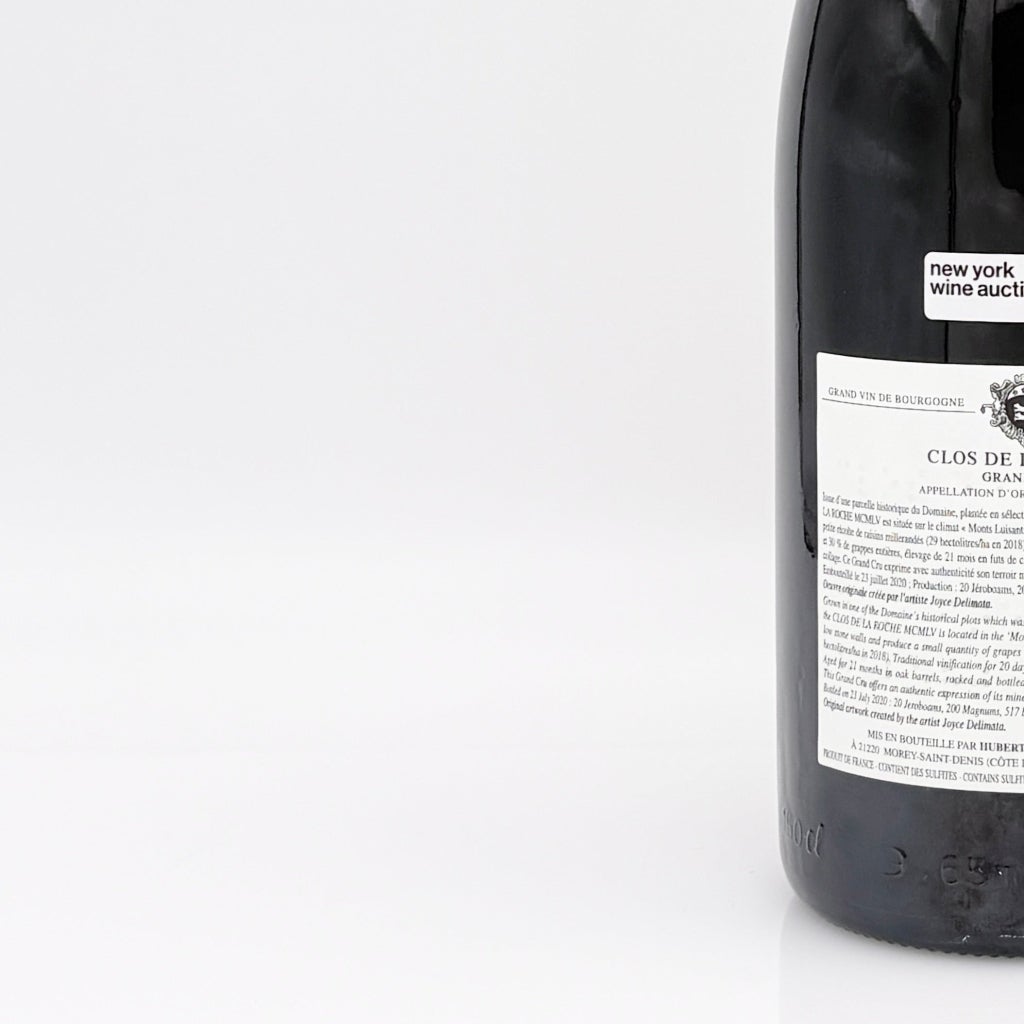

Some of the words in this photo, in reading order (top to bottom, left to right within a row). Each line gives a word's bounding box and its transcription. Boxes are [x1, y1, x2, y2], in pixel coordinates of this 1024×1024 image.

[930, 263, 968, 277] new
[972, 262, 1015, 280] york
[930, 281, 974, 296] wine
[828, 387, 857, 400] GRAND
[859, 391, 876, 402] VIN
[878, 393, 892, 403] DE
[895, 394, 964, 407] BOURGOGNE
[927, 449, 977, 466] CLOS
[985, 451, 1012, 467] DE
[919, 485, 994, 498] APPELLATION
[935, 521, 959, 532] climat
[968, 523, 992, 533] Monts
[932, 551, 942, 561] de
[944, 552, 953, 562] 21
[956, 552, 975, 563] mois
[930, 566, 974, 578] authenticité
[992, 569, 1017, 579] terroir
[912, 579, 952, 591] Production
[959, 582, 969, 592] 20
[899, 592, 929, 604] l'artiste
[929, 595, 953, 609] Joyce
[920, 611, 960, 624] historical
[960, 614, 982, 627] plots
[981, 615, 1009, 626] which
[947, 628, 978, 639] located
[979, 630, 989, 640] in
[990, 630, 1004, 640] the
[921, 641, 943, 652] small
[944, 643, 980, 657] quantity
[992, 649, 1021, 658] grapes
[936, 657, 983, 672] vinification
[983, 660, 997, 672] for
[997, 660, 1011, 670] 20
[945, 673, 976, 684] racked
[937, 687, 981, 702] expression
[992, 690, 1004, 700] its
[945, 702, 961, 713] 200
[962, 703, 1003, 717] Magnums,
[1004, 705, 1020, 715] 517
[919, 715, 941, 726] artist
[941, 717, 965, 731] Joyce
[867, 729, 883, 741] MIS
[884, 732, 897, 743] EN
[899, 734, 954, 749] BOUTEILLE
[957, 740, 977, 750] PAR
[883, 747, 984, 766] MOREY-SAINT-DENIS
[986, 754, 1019, 769] (CÔTE
[924, 768, 957, 780] SULFITES
[962, 772, 999, 783] CONTAINS
